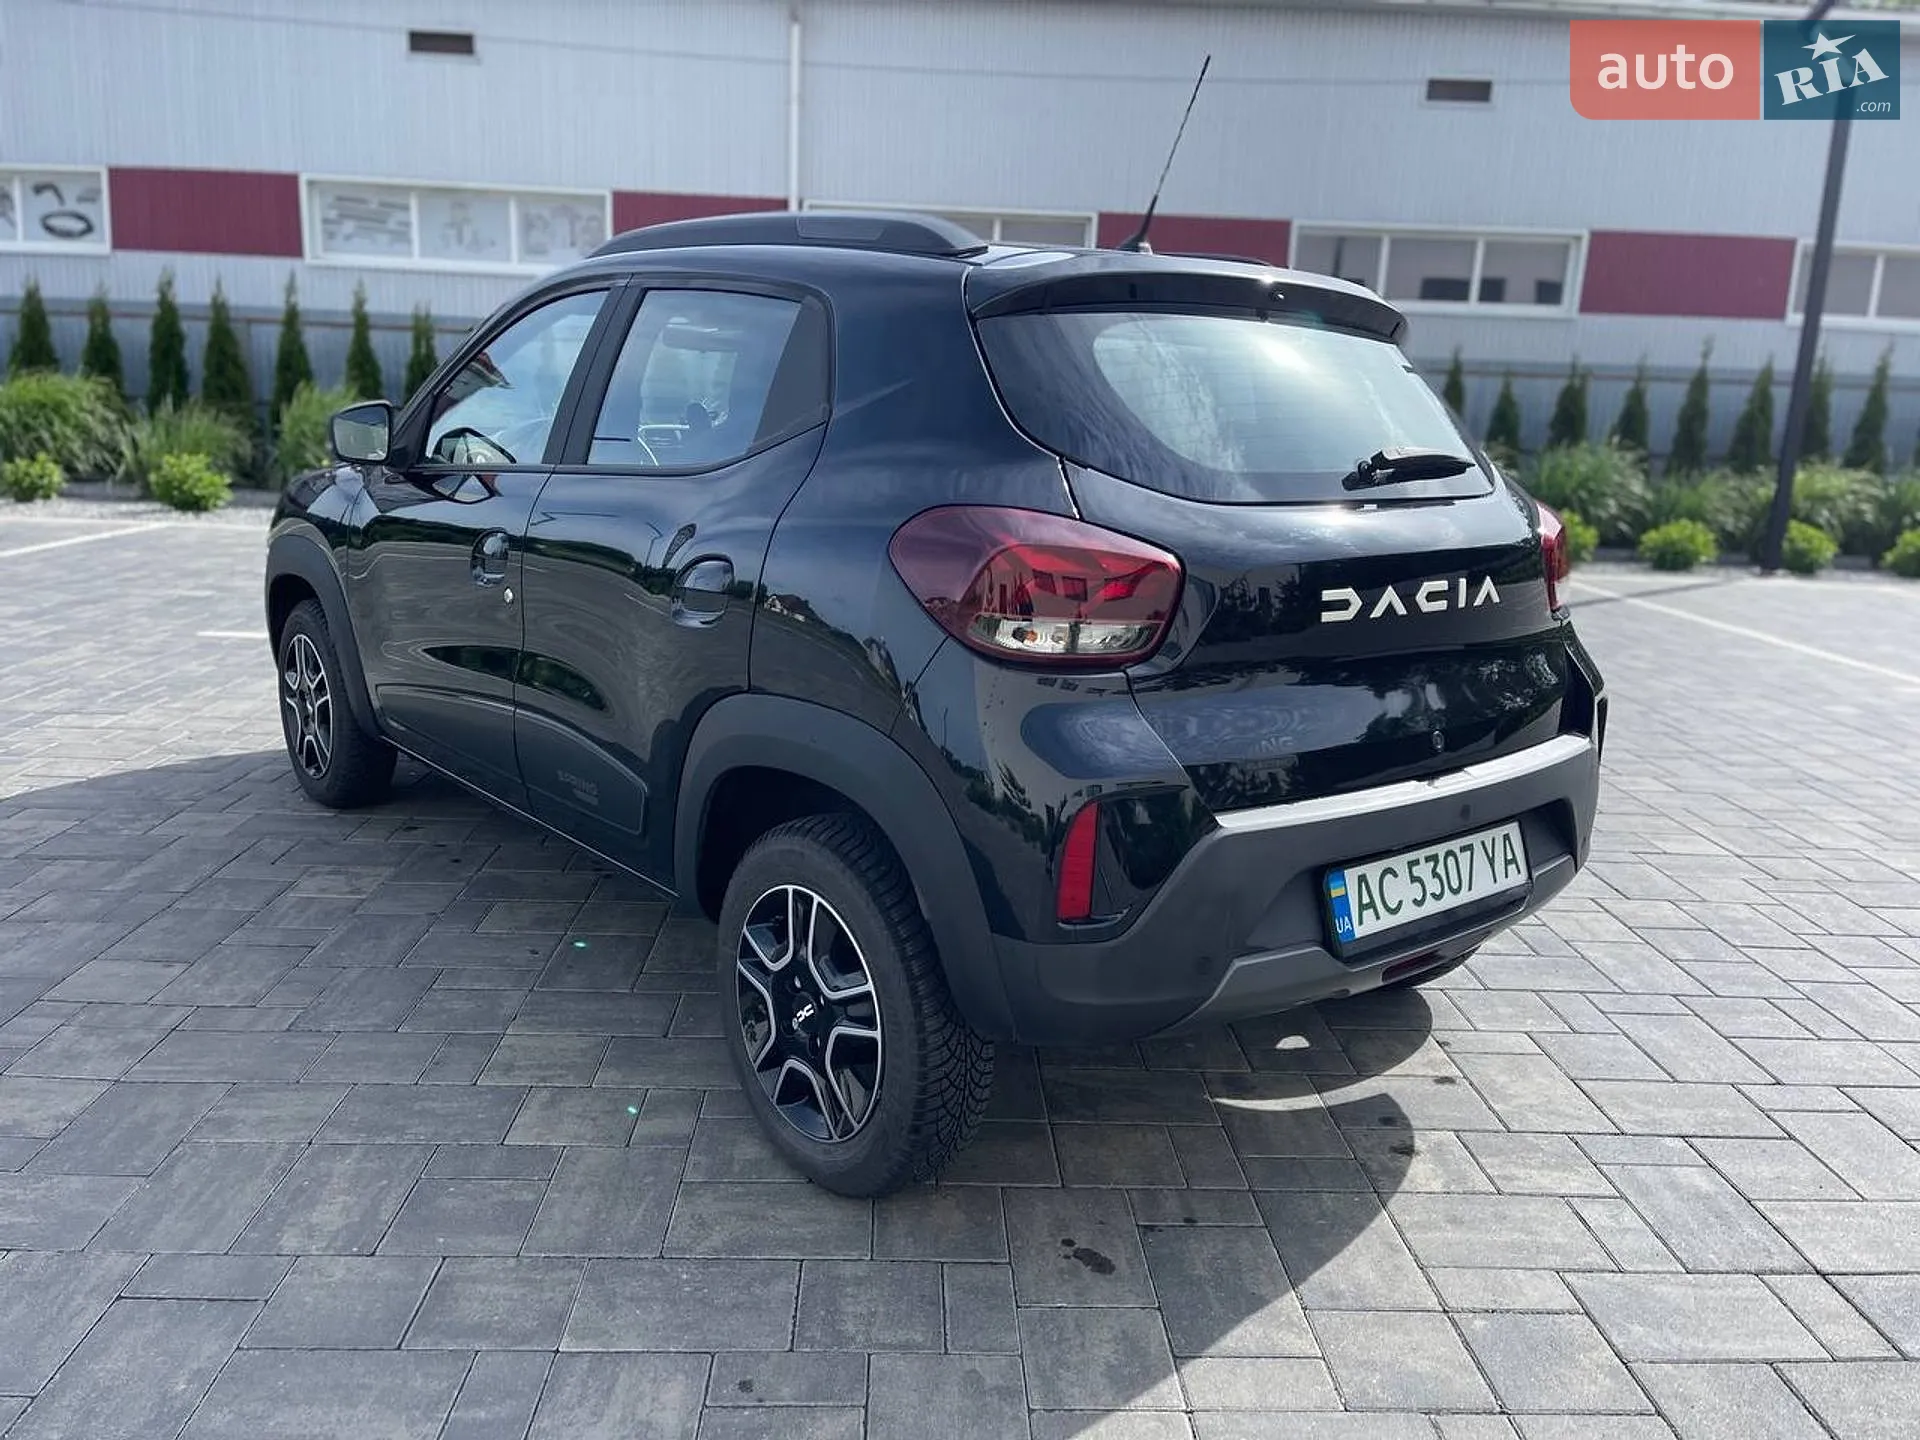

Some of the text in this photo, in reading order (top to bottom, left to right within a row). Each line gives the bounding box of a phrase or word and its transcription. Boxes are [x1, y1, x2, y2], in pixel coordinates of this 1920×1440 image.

[1321, 575, 1500, 623] DACIA
[1357, 832, 1521, 926] AC 5307 YA
[1335, 917, 1353, 934] UA
